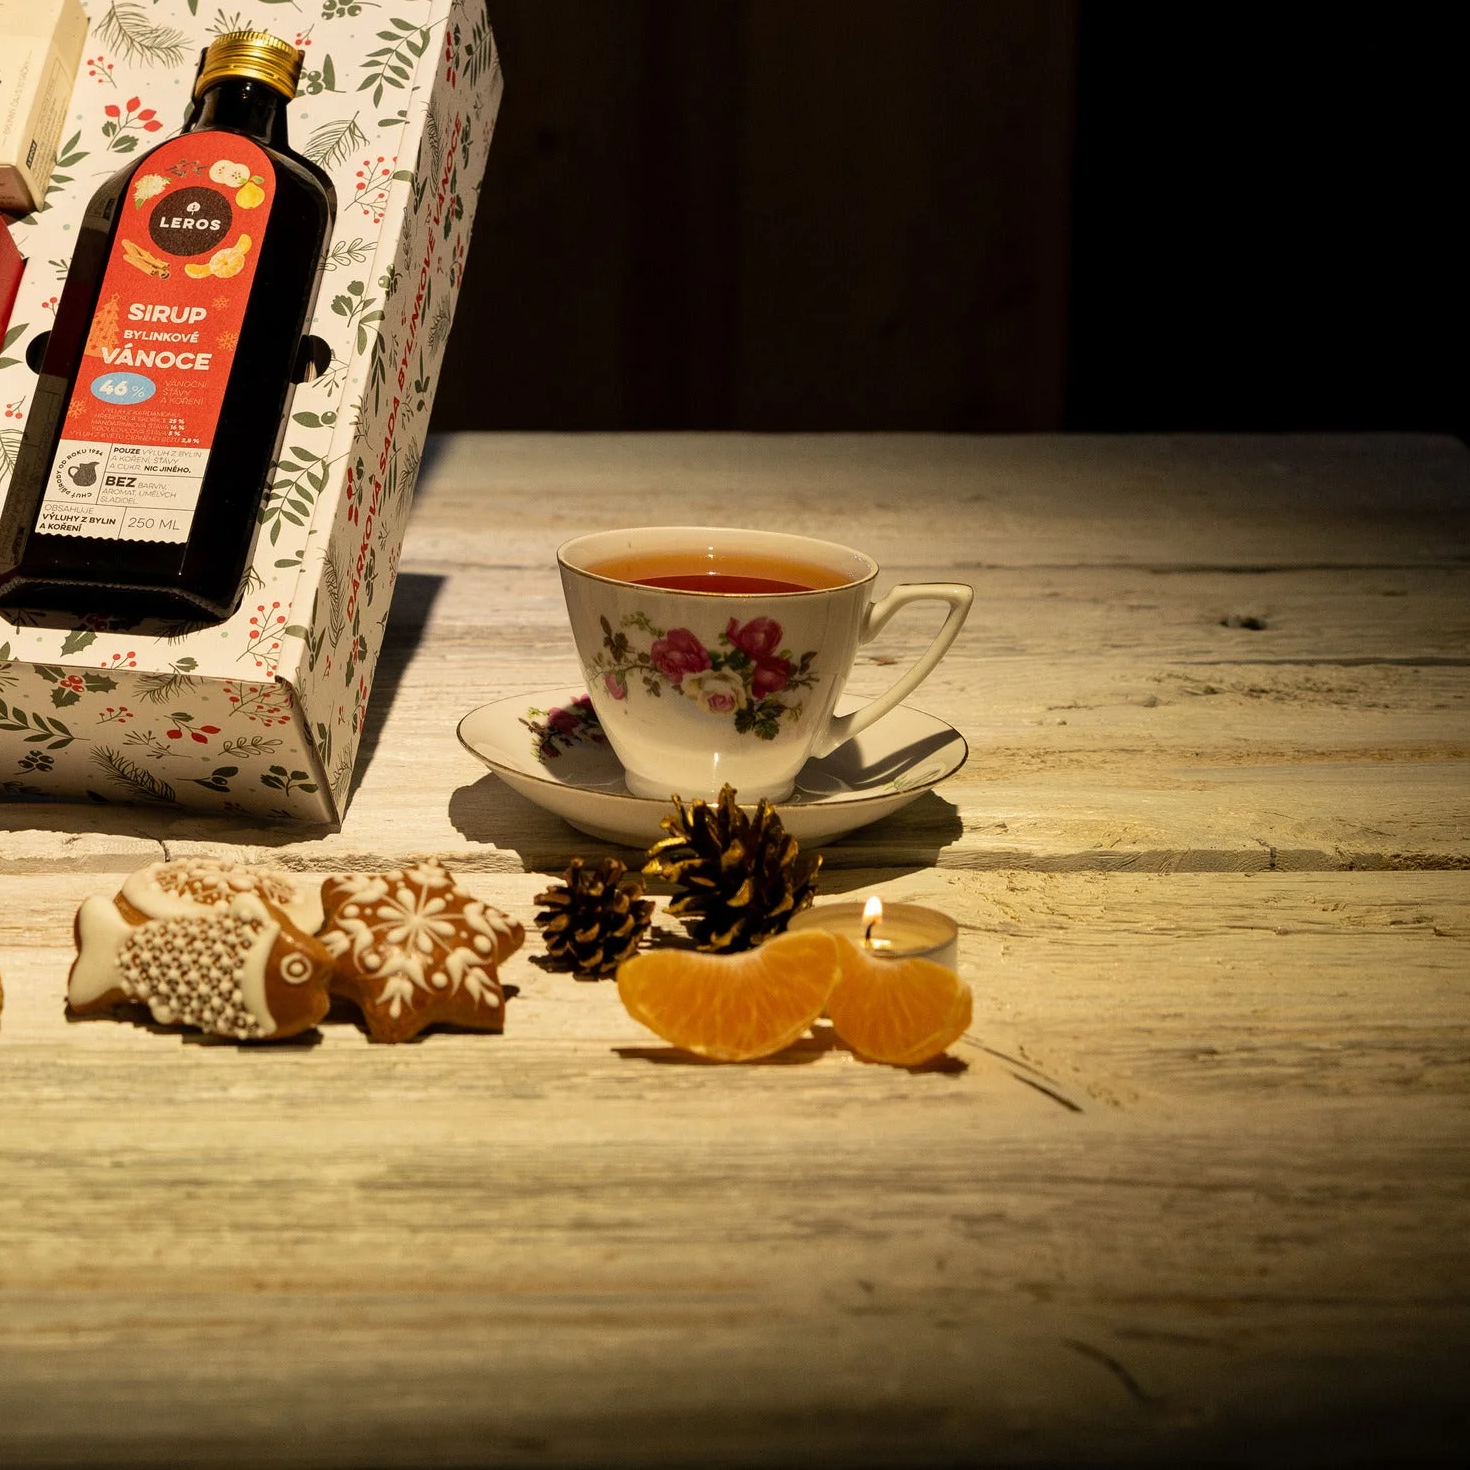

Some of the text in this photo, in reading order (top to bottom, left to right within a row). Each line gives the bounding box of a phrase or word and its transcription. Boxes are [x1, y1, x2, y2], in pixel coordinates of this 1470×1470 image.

[159, 216, 222, 231] LEROS
[127, 303, 207, 324] SIRUP
[123, 329, 200, 343] BYLINKOVÉ
[101, 342, 212, 370] VÁNOCE
[99, 379, 145, 398] 46 %
[164, 379, 207, 388] VÁNOČNÍ
[169, 397, 203, 406] KOŘENÍ
[66, 449, 87, 460] ROKU
[89, 448, 104, 456] 1954
[113, 447, 141, 455] POUZE
[142, 447, 170, 457] VÝLUH
[178, 450, 202, 458] BYLIN
[58, 460, 67, 469] OD
[153, 456, 179, 465] ŠŤÁVY
[159, 464, 191, 474] JINÉHO.
[56, 470, 71, 495] PŘÍRODY
[105, 476, 137, 488] BEZ
[139, 489, 177, 498] UMĚLÝCH
[44, 504, 94, 514] OBSAHUJE
[42, 512, 80, 522] VÝLUHY
[89, 517, 116, 525] BYLIN
[47, 523, 82, 532] KOŘENÍ
[128, 518, 180, 531] 250 ML
